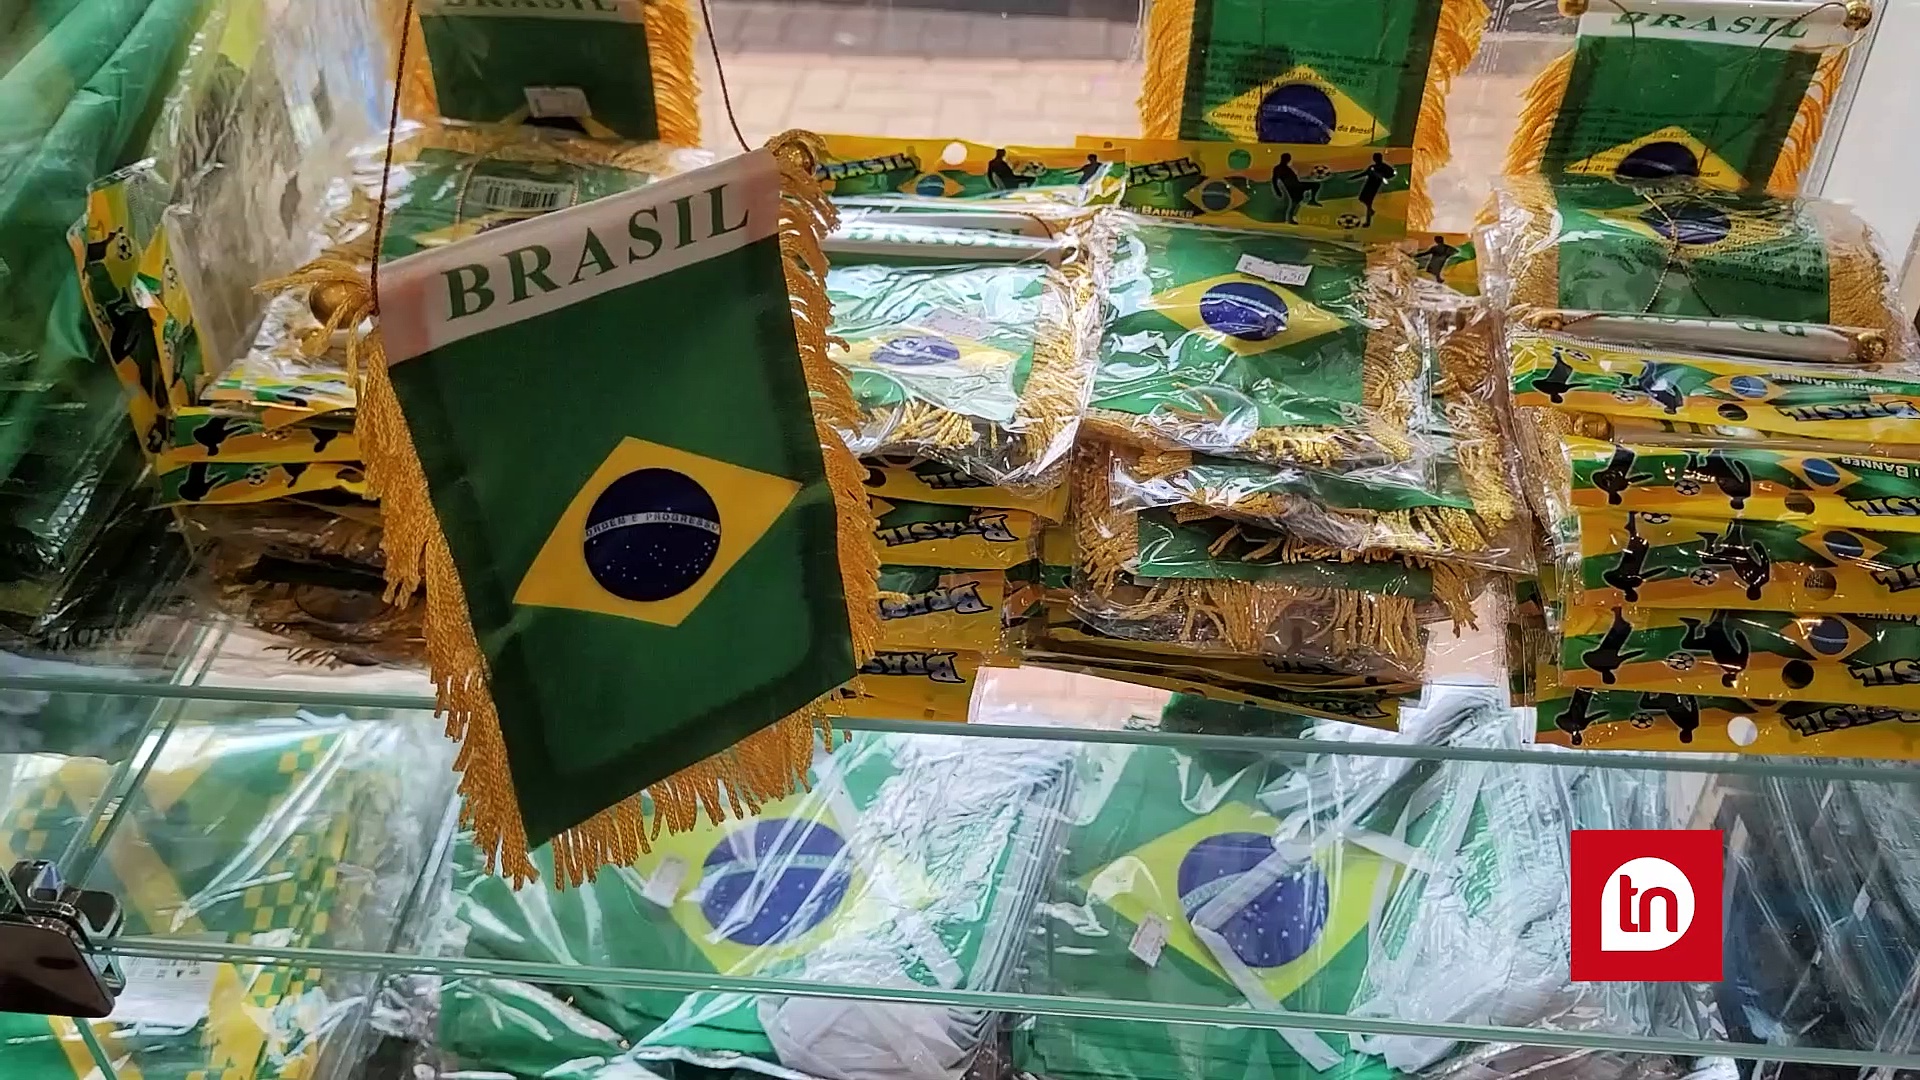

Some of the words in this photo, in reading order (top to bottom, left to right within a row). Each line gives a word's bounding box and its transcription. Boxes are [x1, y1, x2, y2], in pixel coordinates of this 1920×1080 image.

[1611, 11, 1809, 38] BRASIL
[440, 183, 749, 322] BRASIL
[1840, 456, 1910, 480] BANNER
[632, 514, 639, 523] E
[859, 652, 966, 683] BRAS
